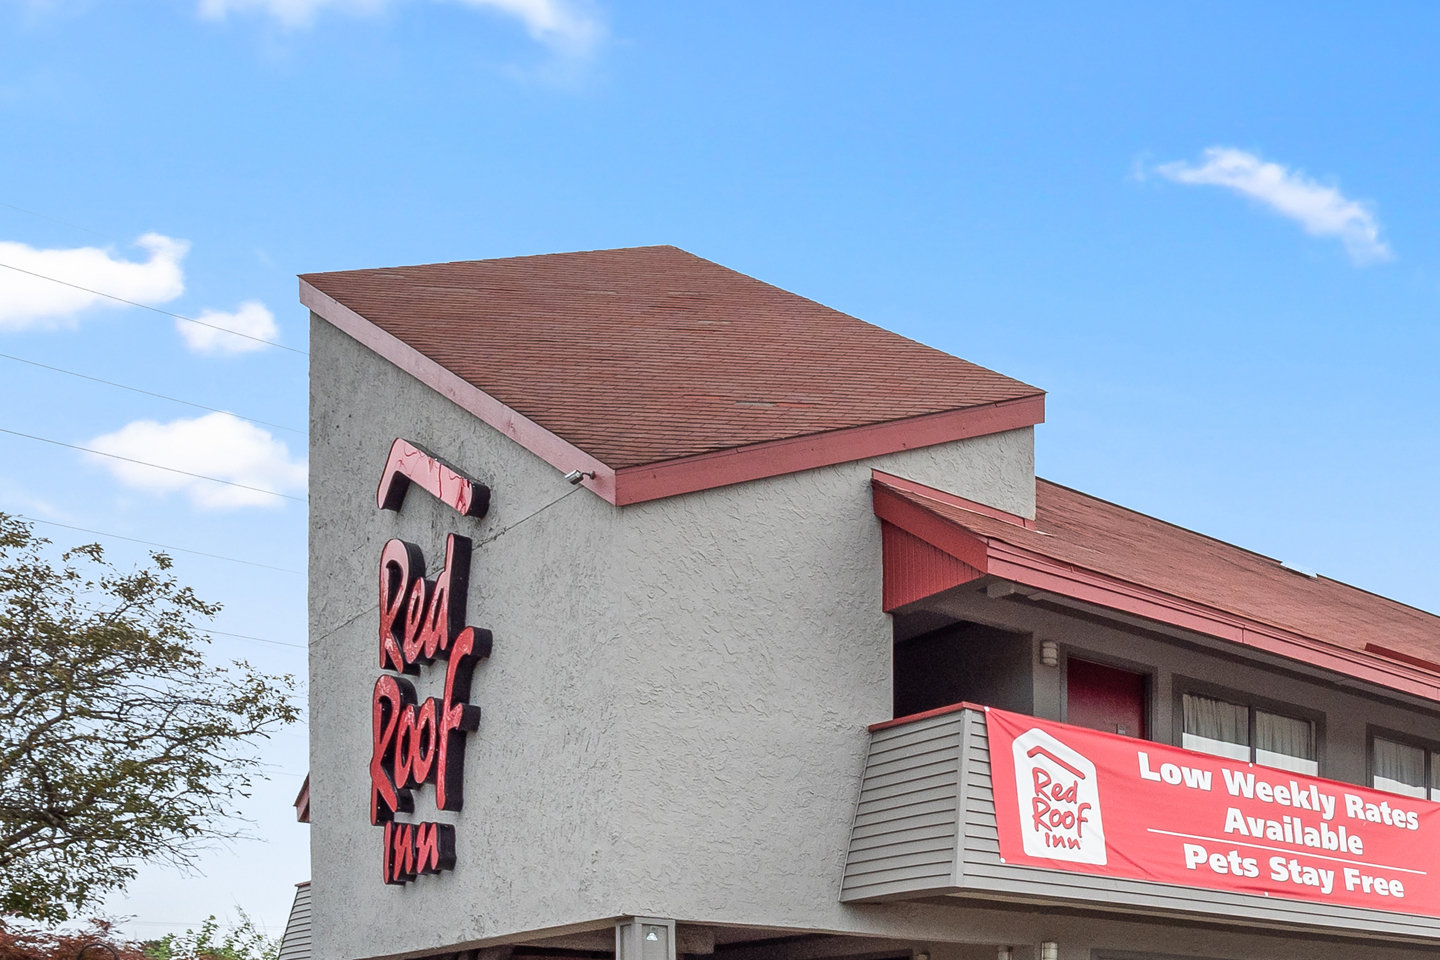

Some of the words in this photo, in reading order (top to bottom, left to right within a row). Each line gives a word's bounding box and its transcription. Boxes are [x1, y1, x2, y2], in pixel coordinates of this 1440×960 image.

[379, 532, 472, 675] Red
[370, 627, 492, 826] Roof
[1032, 766, 1078, 804] Red
[1137, 751, 1213, 791] Low
[1221, 768, 1336, 820] Weekly
[1344, 793, 1420, 831] Rates
[1032, 797, 1092, 838] Roof
[1224, 807, 1364, 855] Available
[1183, 843, 1260, 878] Pets
[1269, 856, 1335, 895] Stay
[1343, 867, 1405, 898] Free
